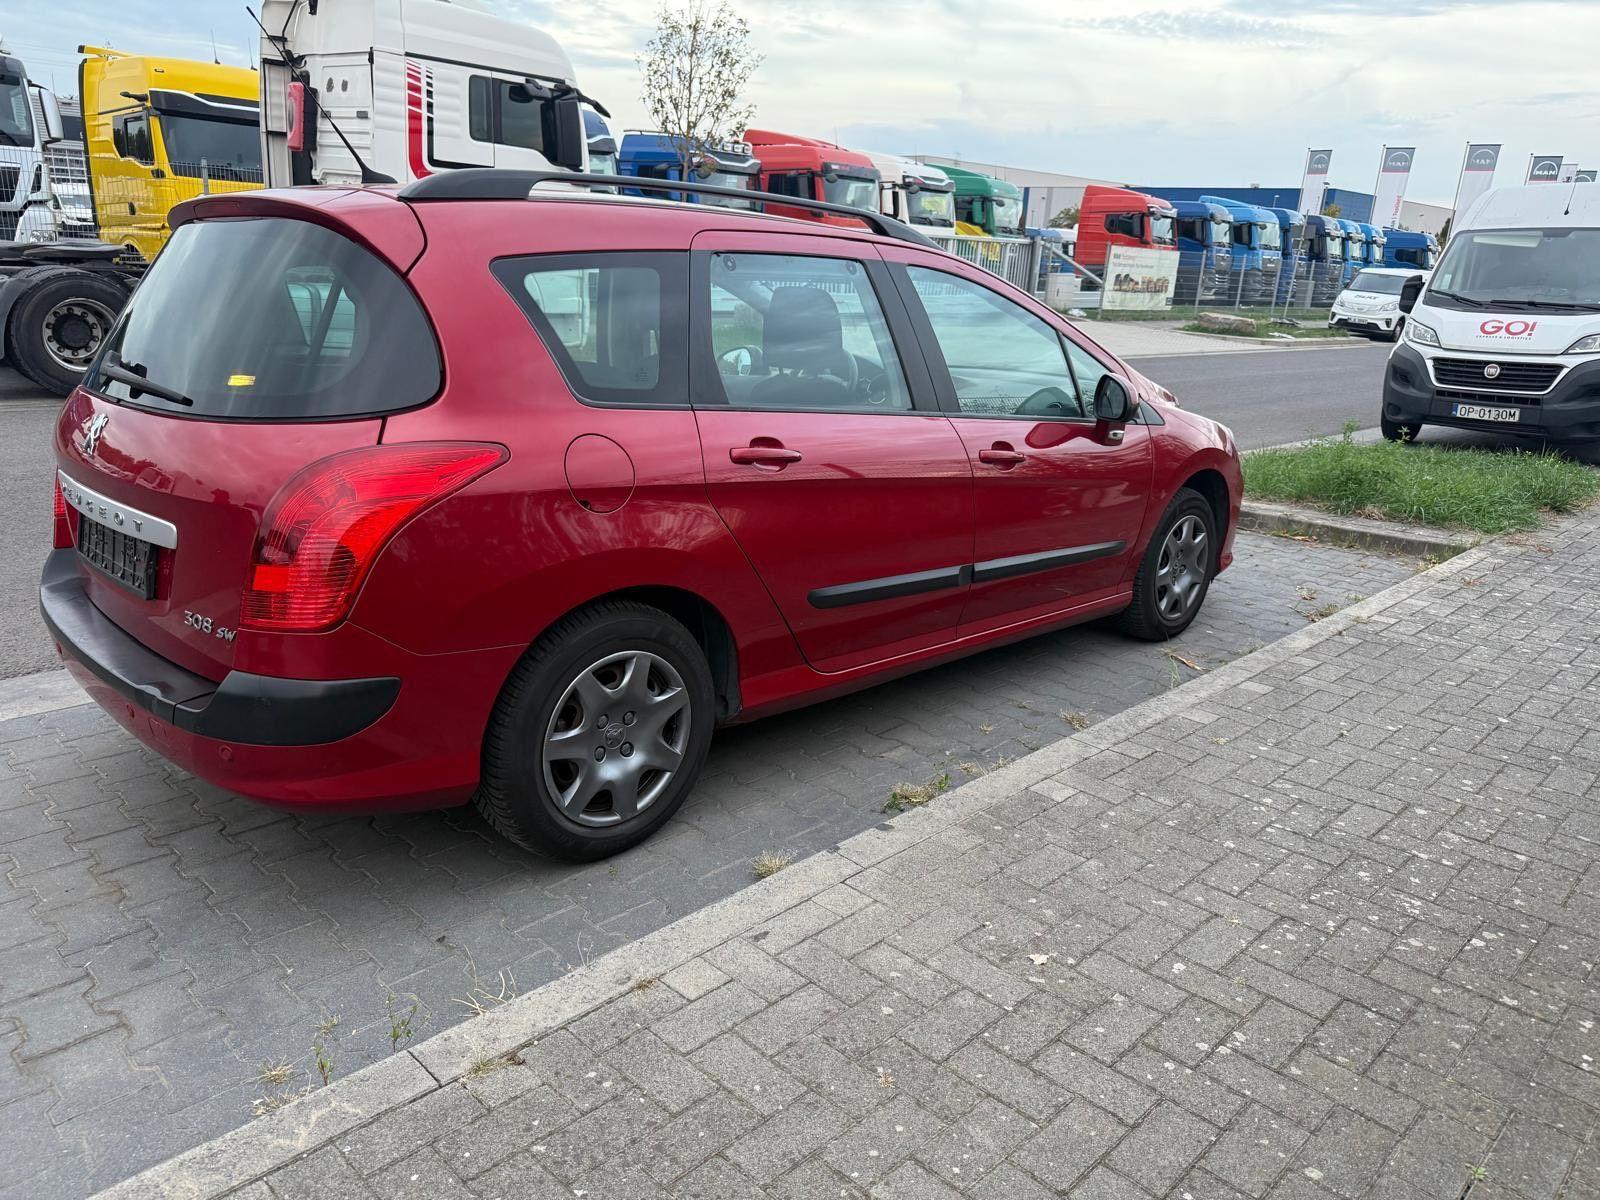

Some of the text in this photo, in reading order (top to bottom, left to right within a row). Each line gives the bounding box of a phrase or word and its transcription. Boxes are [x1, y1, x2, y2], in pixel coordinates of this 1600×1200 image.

[1479, 319, 1537, 336] GO!
[1459, 406, 1475, 417] OP
[61, 482, 144, 533] PEUGEOT
[184, 610, 237, 642] 308 SW
